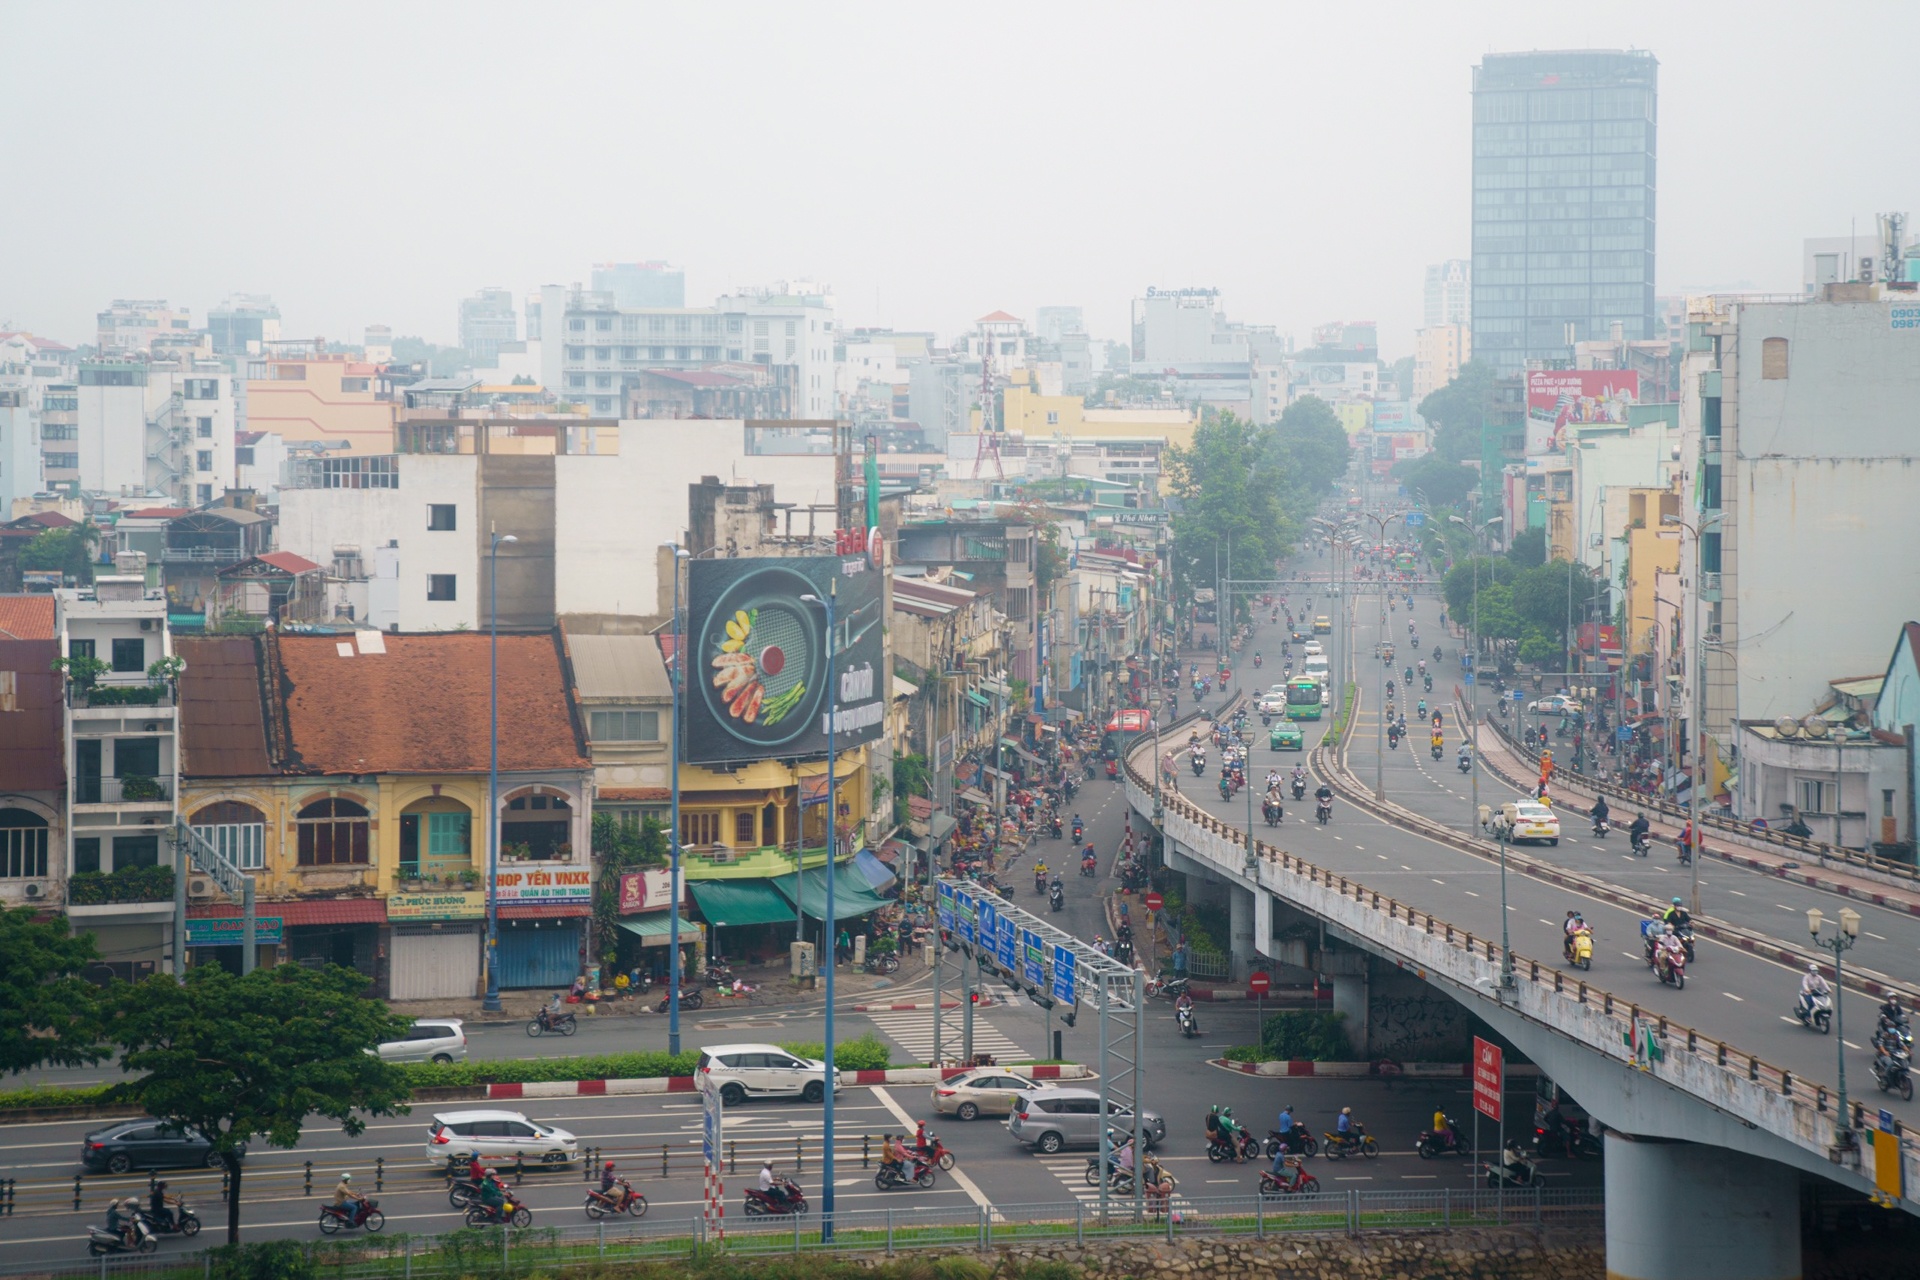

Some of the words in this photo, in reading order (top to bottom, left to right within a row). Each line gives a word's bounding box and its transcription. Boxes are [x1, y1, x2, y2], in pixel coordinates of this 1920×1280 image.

[1146, 286, 1219, 298] Sacombank
[1891, 309, 1920, 318] 0903
[1891, 319, 1920, 328] 0987
[833, 525, 868, 556] Tefal
[526, 869, 551, 886] YẾN
[554, 871, 590, 885] VNXK
[568, 887, 590, 896] TRANG
